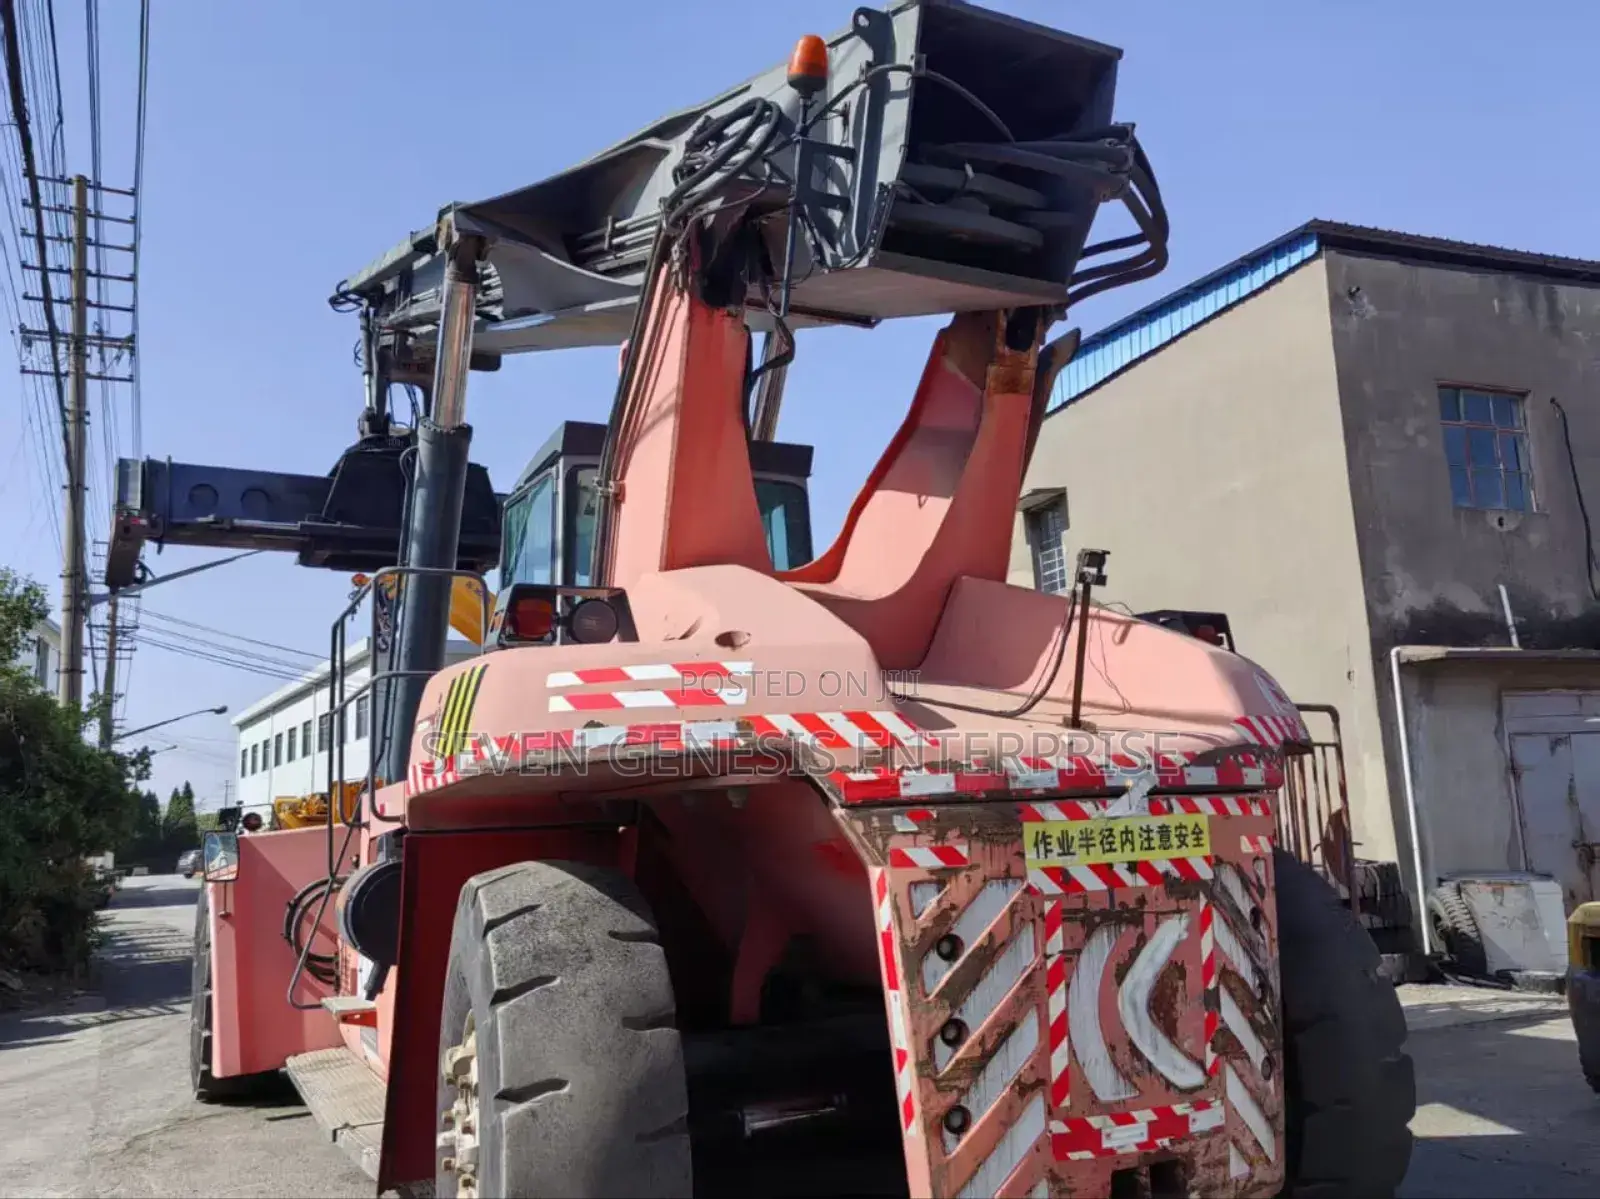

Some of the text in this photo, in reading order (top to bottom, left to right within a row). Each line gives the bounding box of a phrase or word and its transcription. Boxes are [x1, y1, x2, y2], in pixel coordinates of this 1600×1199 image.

[1033, 821, 1205, 859] 作业半径内注意安全
